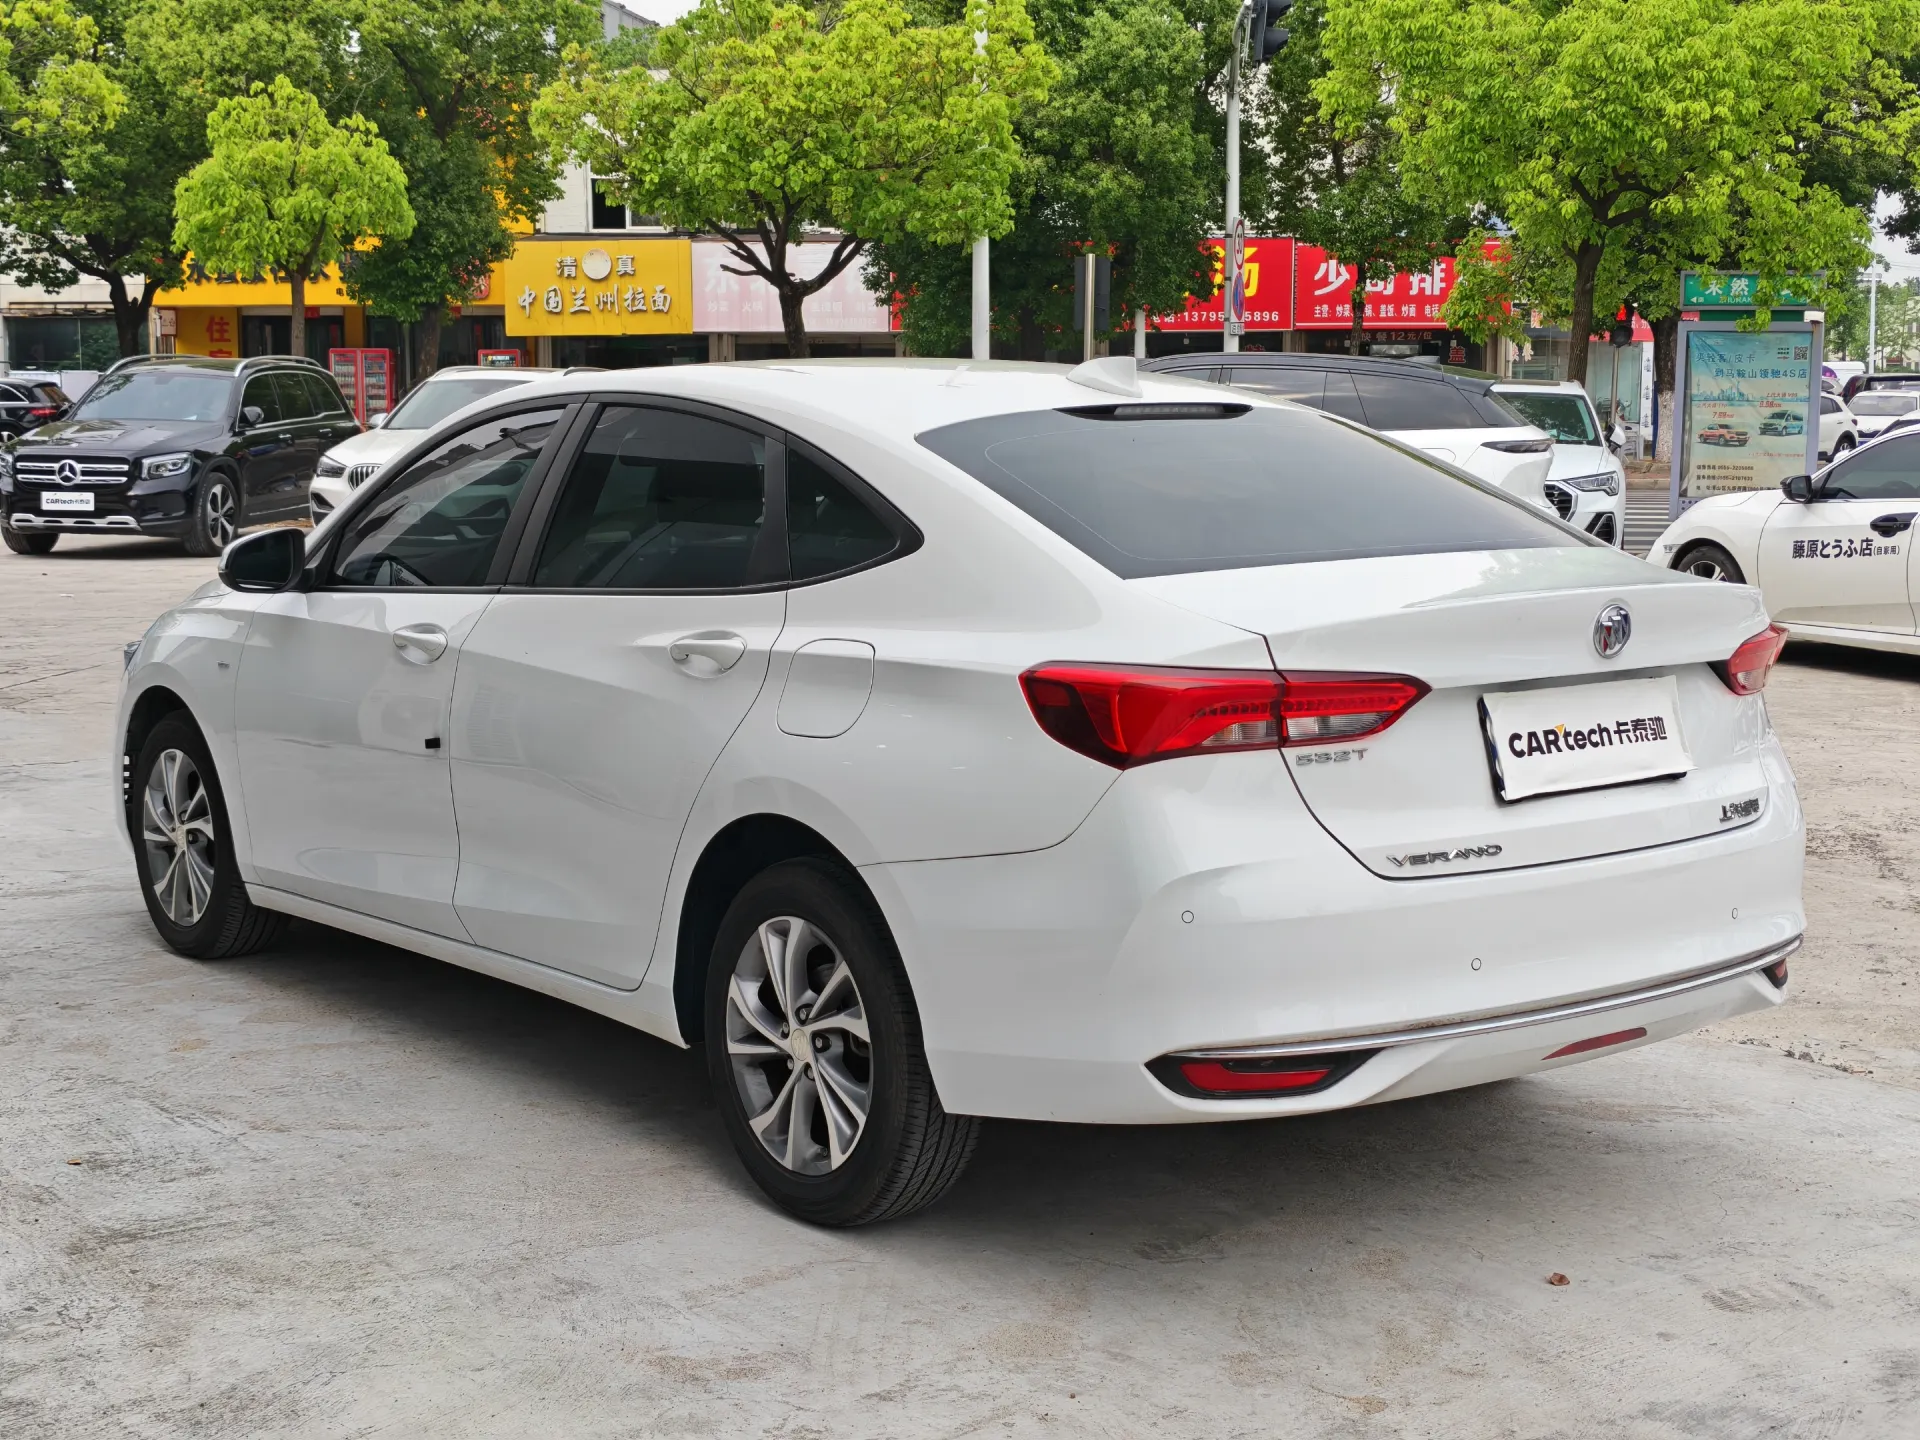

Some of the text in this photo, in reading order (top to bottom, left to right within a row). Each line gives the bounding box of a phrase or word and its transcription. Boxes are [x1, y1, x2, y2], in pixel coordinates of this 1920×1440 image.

[517, 284, 672, 319] 中国兰州拉面
[1385, 844, 1503, 868] VERANO
